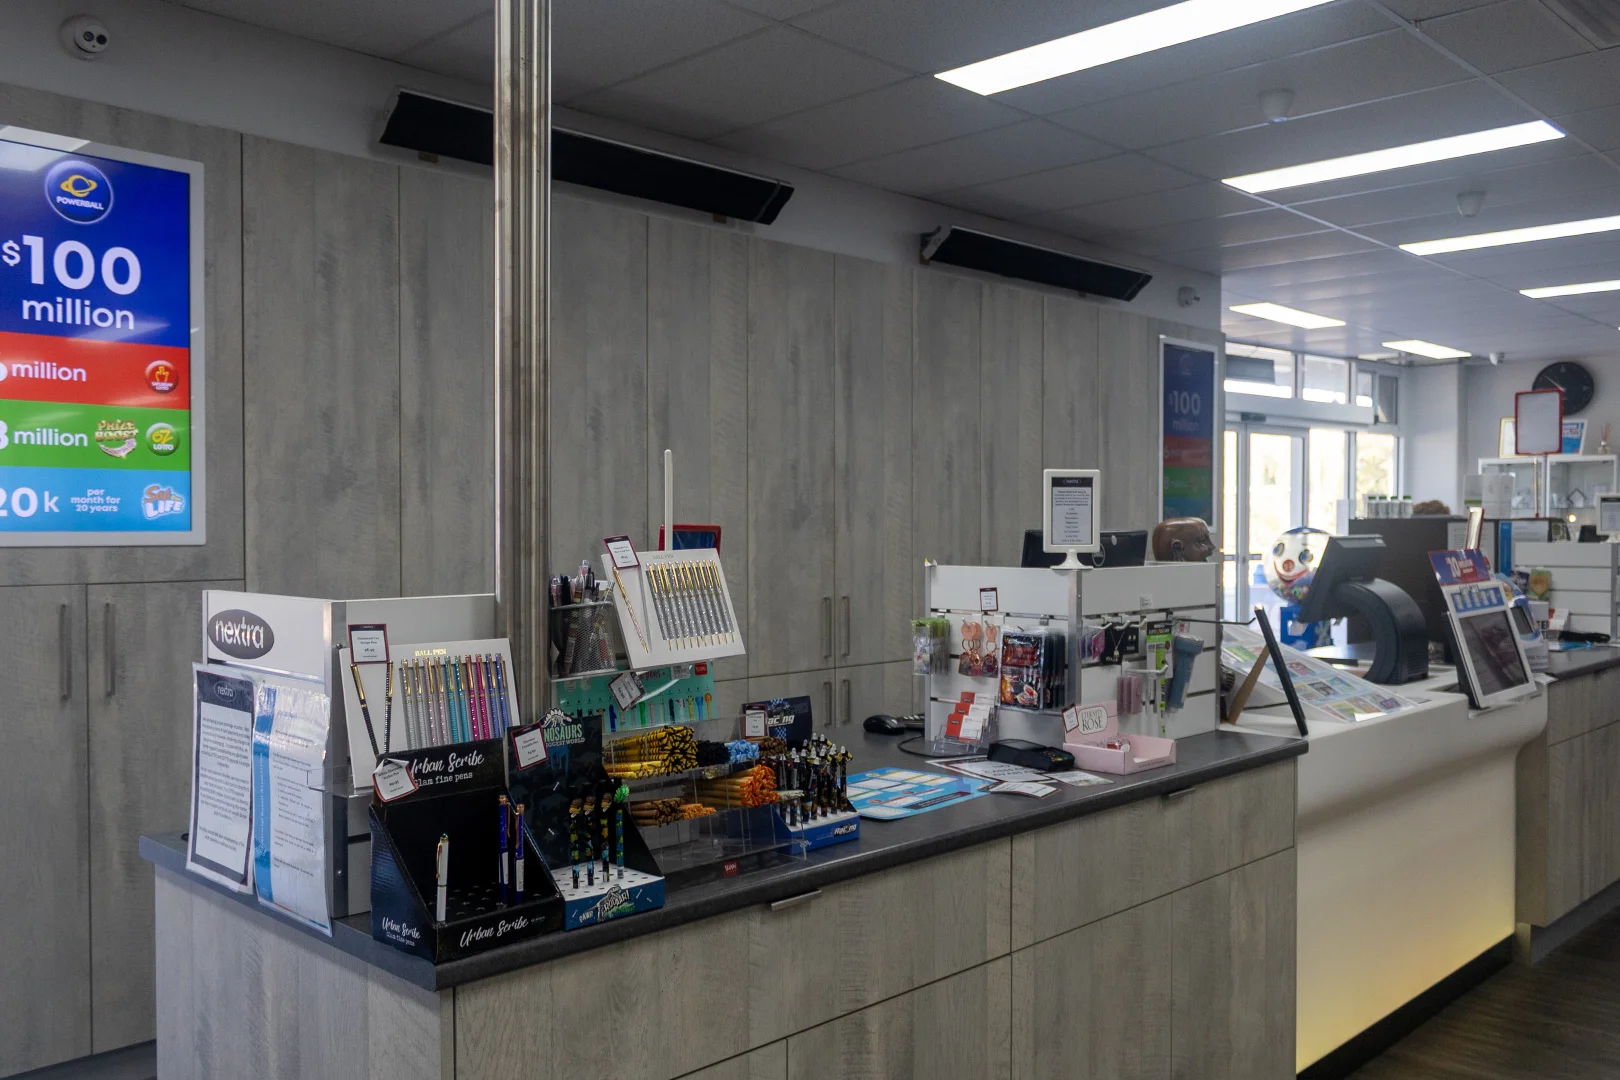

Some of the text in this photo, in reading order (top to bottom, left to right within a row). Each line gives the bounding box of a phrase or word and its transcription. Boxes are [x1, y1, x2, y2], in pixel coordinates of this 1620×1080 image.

[56, 196, 104, 210] POWERBALL
[2, 235, 141, 296] $100
[22, 297, 134, 330] million
[12, 361, 87, 382] million
[99, 420, 135, 431] PRIZE
[14, 428, 88, 447] million
[95, 430, 139, 442] BOOST
[153, 443, 174, 451] LOTTO
[71, 496, 121, 504] month for
[87, 488, 105, 497] per
[144, 485, 171, 503] Set
[44, 490, 60, 513] k
[76, 504, 118, 513] 20 years
[144, 502, 183, 519] LIFE
[215, 616, 264, 649] nextra
[415, 649, 433, 657] BALL
[543, 723, 583, 742] NOSAURS
[1082, 717, 1104, 731] ROSE
[545, 740, 566, 748] IGGEST
[566, 737, 586, 745] WORLD
[447, 750, 485, 773] Scribe
[435, 773, 453, 785] fine
[454, 771, 473, 784] pens
[382, 917, 422, 940] Urban Scribe
[459, 915, 529, 948] Urban Scribe
